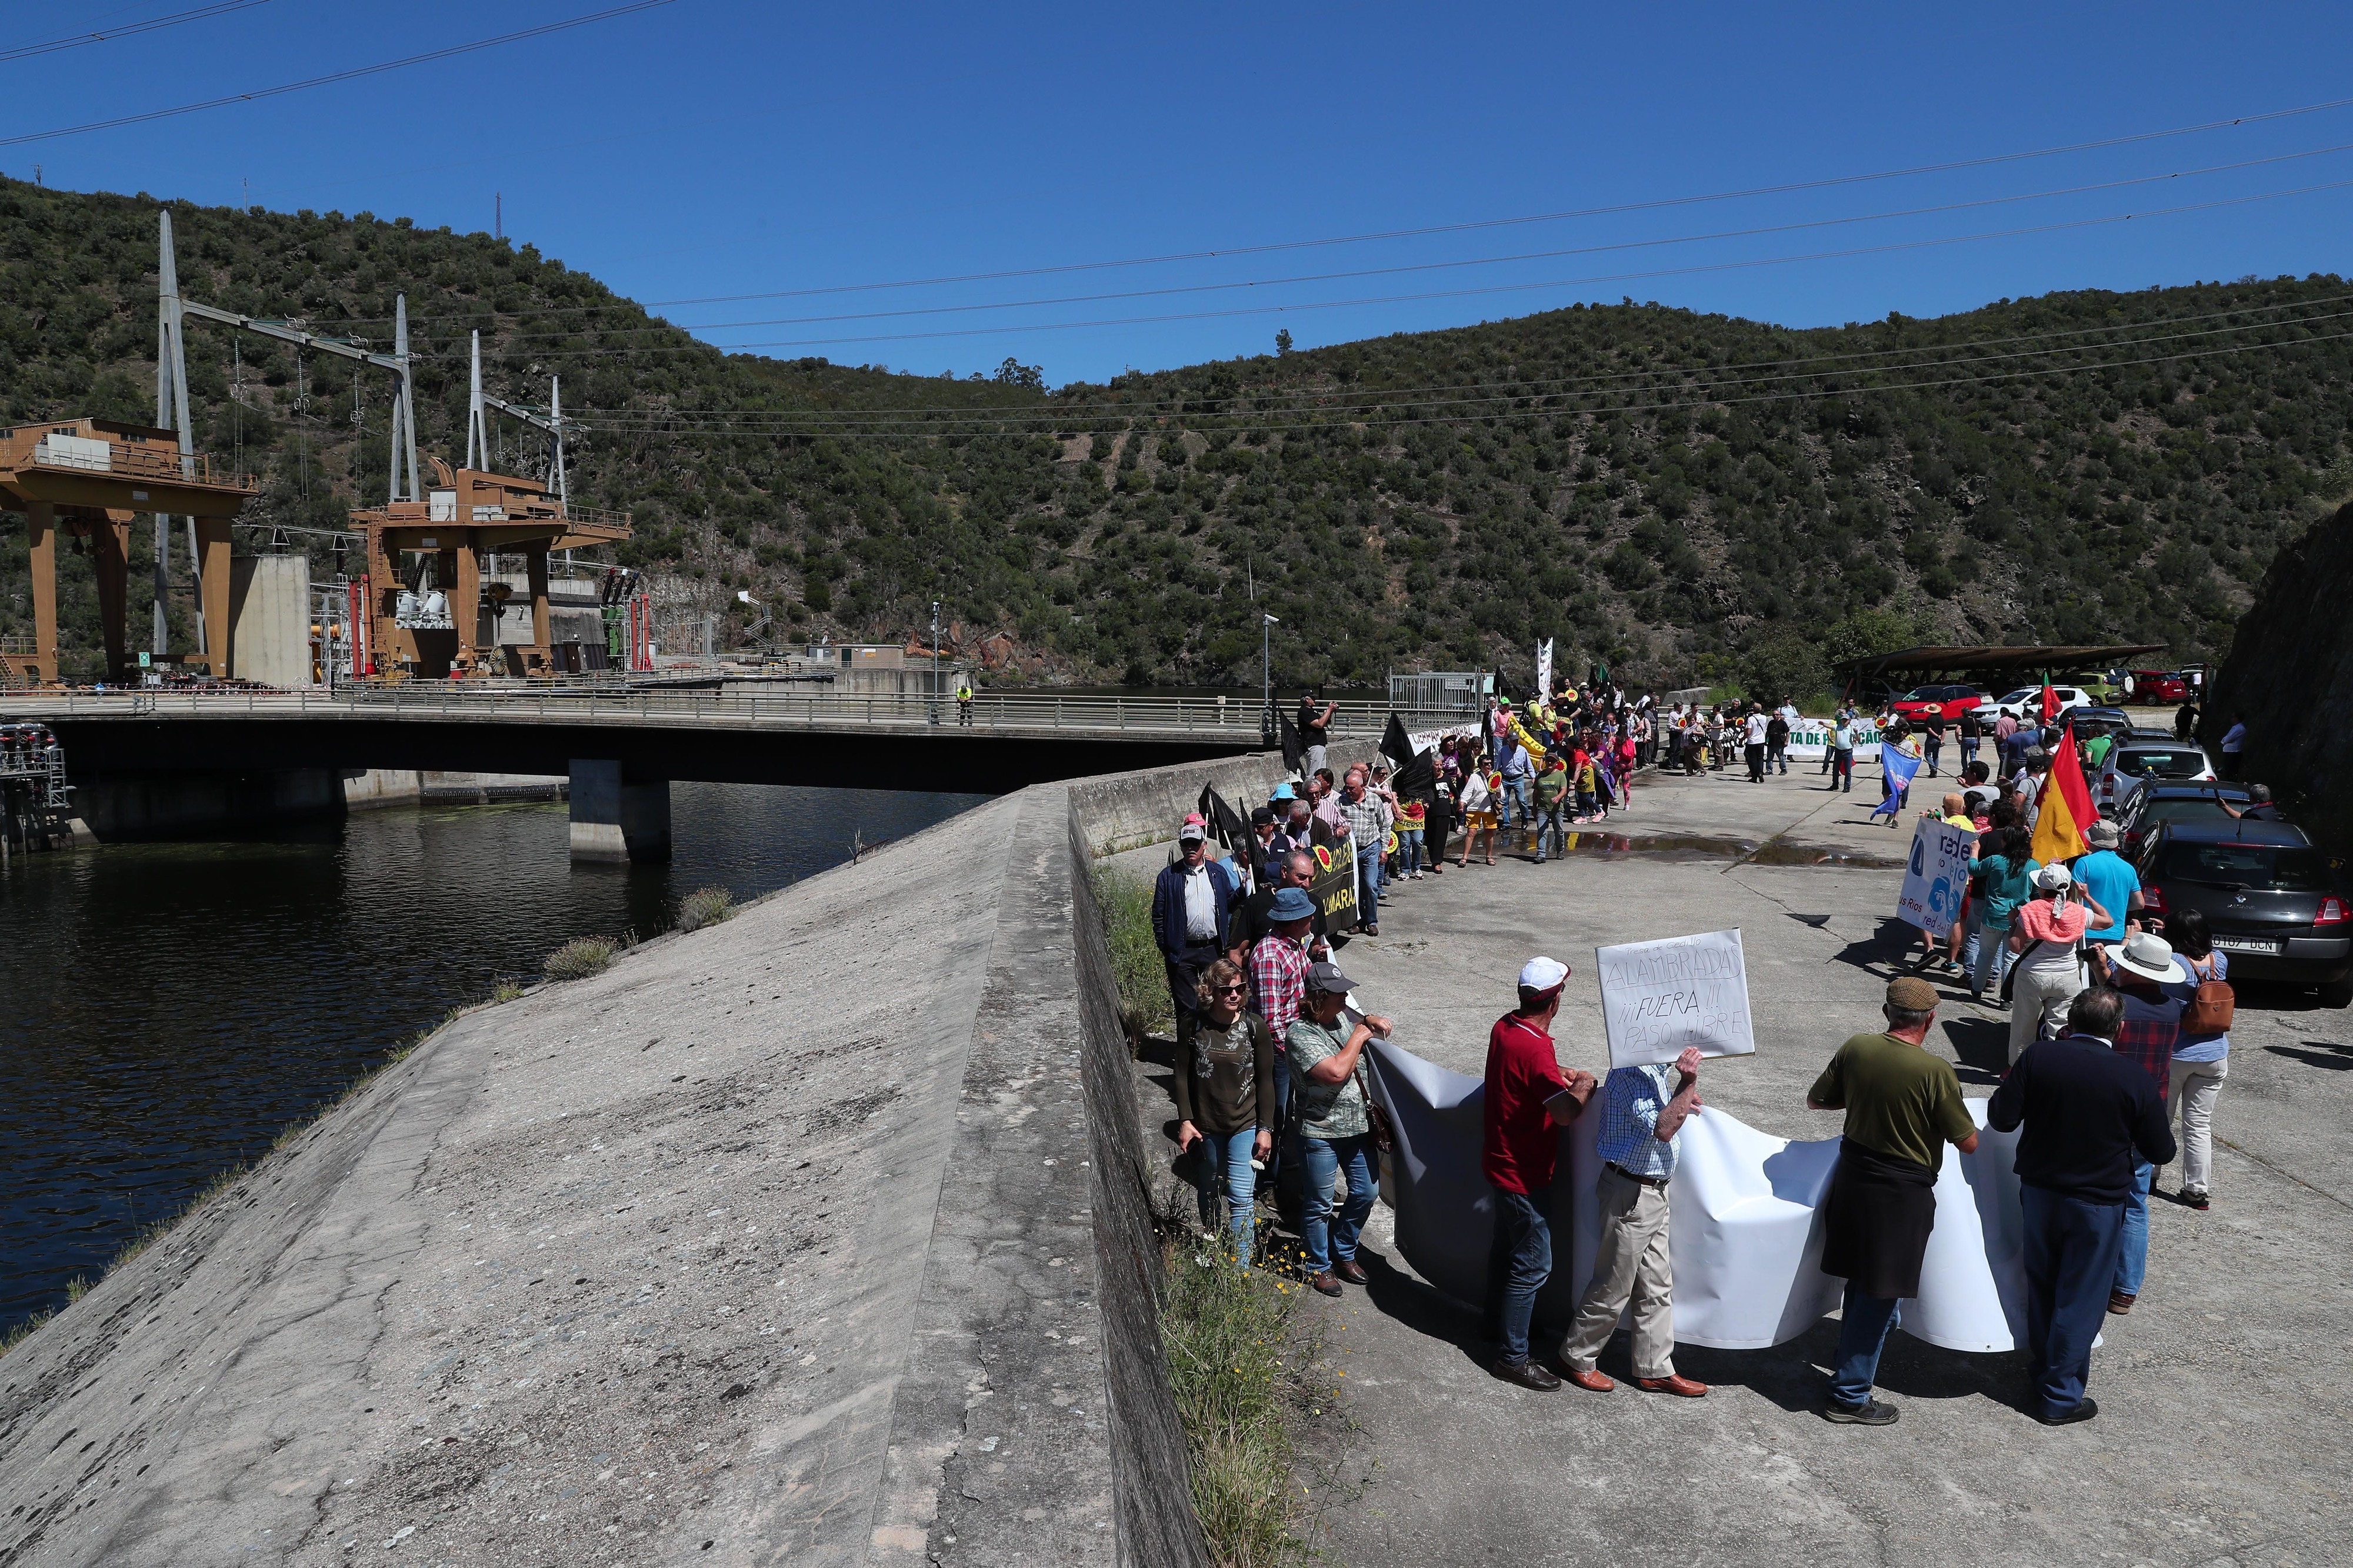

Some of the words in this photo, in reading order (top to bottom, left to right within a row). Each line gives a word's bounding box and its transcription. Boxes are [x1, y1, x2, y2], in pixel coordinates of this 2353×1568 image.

[1789, 732, 1803, 745] TA
[1805, 732, 1819, 745] DE
[1858, 729, 1881, 747] ÇÃO
[1922, 915, 1938, 928] red
[1937, 922, 1947, 932] del
[1625, 947, 1650, 955] Presa
[1666, 938, 1701, 949] Cedillo
[2213, 935, 2243, 948] 0107
[2250, 938, 2272, 950] DCN
[1605, 944, 1741, 987] ALAMBRADAS
[1624, 1022, 1672, 1050] PASO
